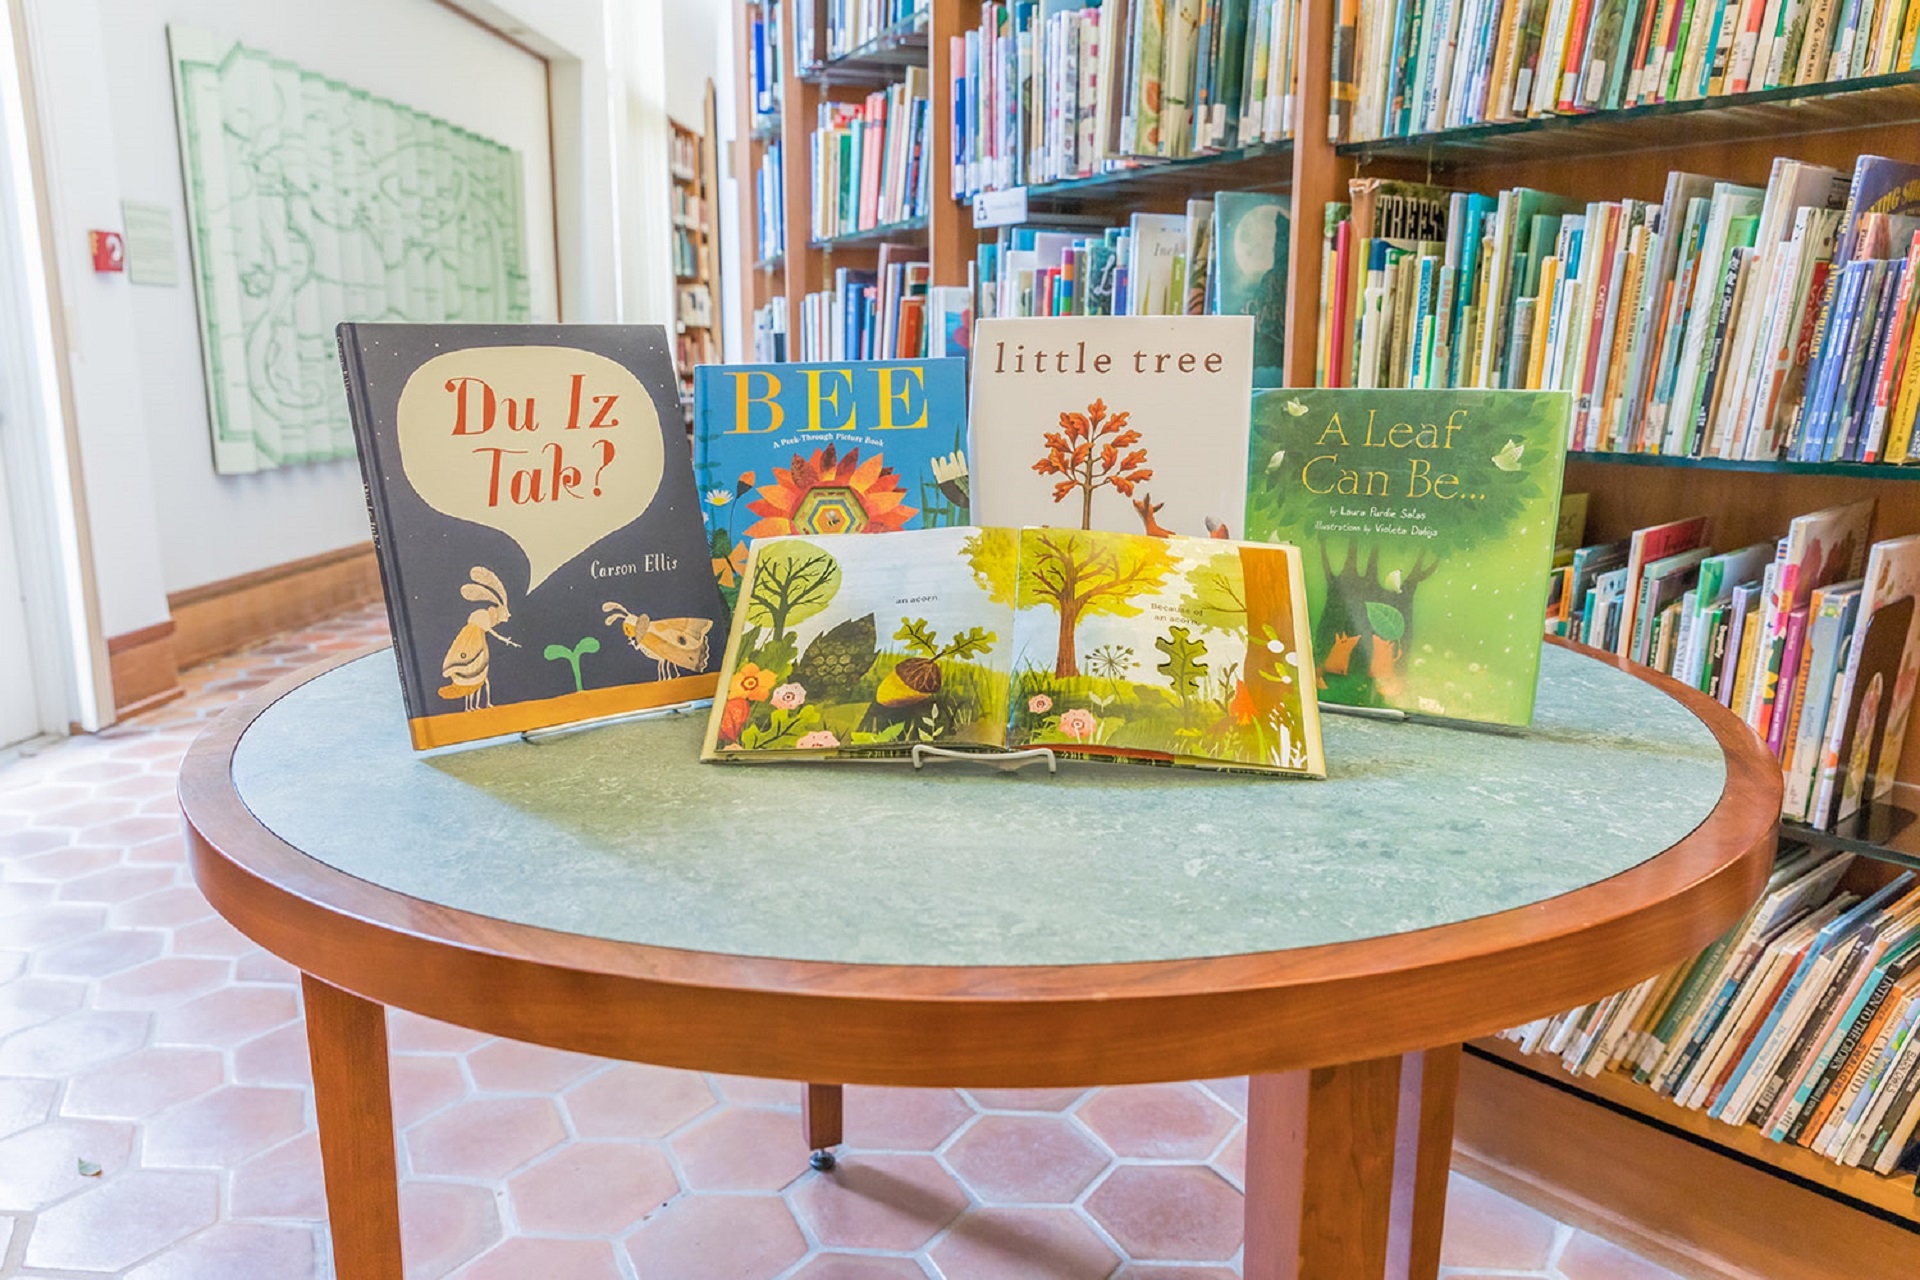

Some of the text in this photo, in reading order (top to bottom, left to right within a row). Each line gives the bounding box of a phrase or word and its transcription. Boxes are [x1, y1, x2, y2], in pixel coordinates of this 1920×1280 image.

[1377, 194, 1440, 240] TREES
[1593, 284, 1607, 320] CACTUS
[994, 341, 1223, 374] little tree
[444, 374, 620, 436] Du Iz
[723, 366, 928, 434] BEE
[773, 441, 781, 449] A
[835, 433, 863, 444] Picture
[864, 437, 885, 448] Book
[1315, 409, 1468, 450] A Leaf
[472, 439, 616, 507] Tak?
[1302, 453, 1486, 500] Can Be...
[1340, 506, 1367, 518] Laura
[1370, 506, 1396, 519] Purdie
[1400, 507, 1427, 520] Salas
[1375, 523, 1408, 535] Violeta
[590, 553, 678, 580] Carson Ellis
[1151, 603, 1203, 617] Because of
[1713, 624, 1728, 659] Dragonfly
[1830, 976, 1895, 1070] LISTEN TO THE CROWS
[1830, 1043, 1866, 1097] SWALLOWS
[1850, 1036, 1889, 1093] CATBIRD
[1886, 1051, 1917, 1094] BARN OWLS
